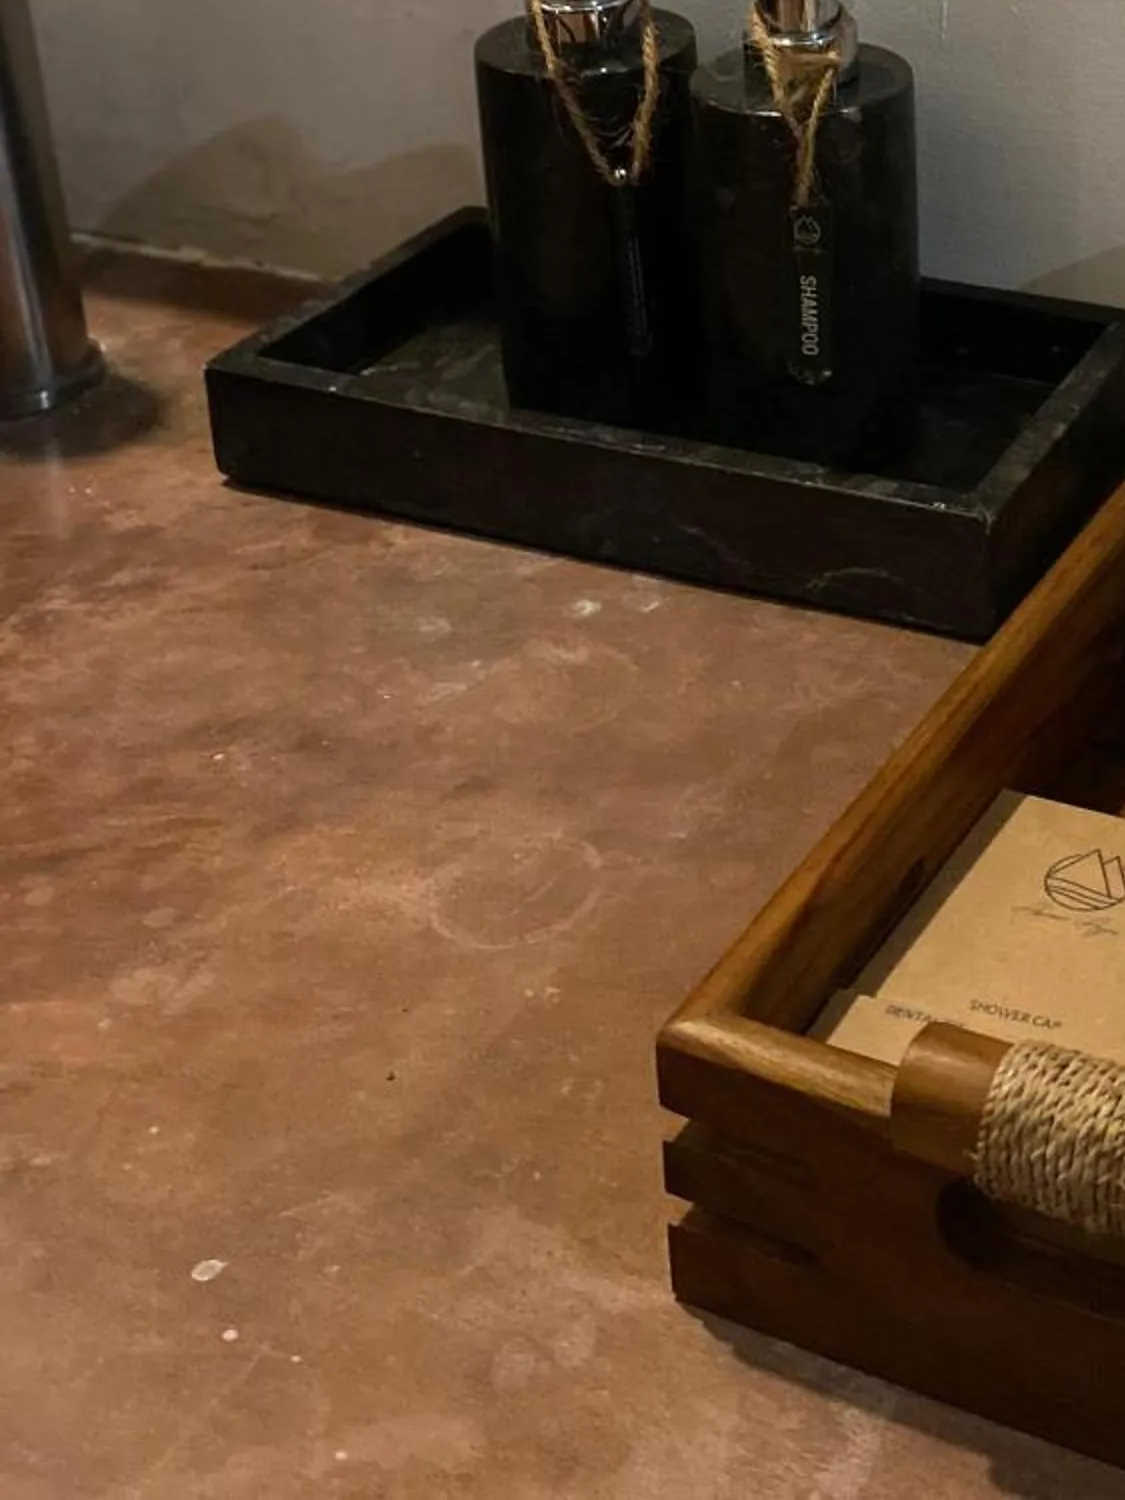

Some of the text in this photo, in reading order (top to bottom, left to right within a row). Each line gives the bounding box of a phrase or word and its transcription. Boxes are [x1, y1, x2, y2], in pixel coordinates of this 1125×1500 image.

[800, 275, 819, 355] SHAMPOO
[885, 1003, 937, 1021] DENTA
[969, 999, 1031, 1023] SHOWER
[1031, 1015, 1063, 1028] CAP
